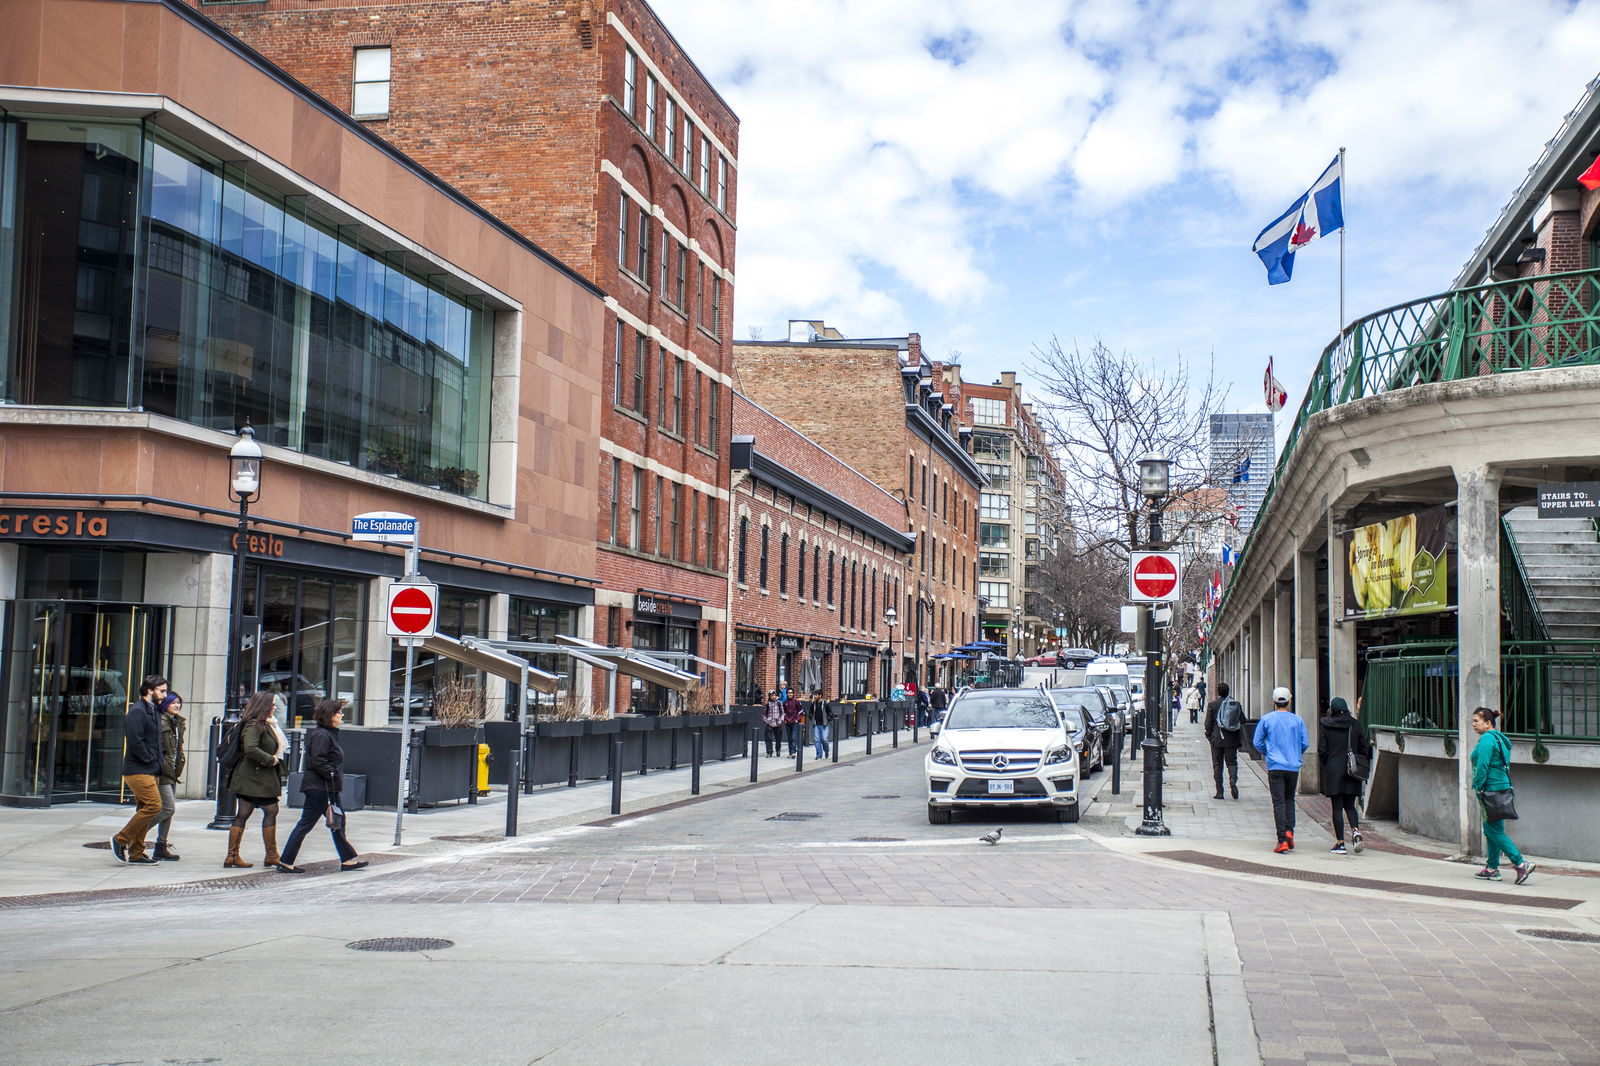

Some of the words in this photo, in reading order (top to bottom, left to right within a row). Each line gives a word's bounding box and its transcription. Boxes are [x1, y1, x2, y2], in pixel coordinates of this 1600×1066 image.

[1541, 492, 1571, 500] STAIRS
[1570, 500, 1596, 508] LEVEL
[353, 519, 369, 530] The
[370, 519, 413, 533] Esplanade
